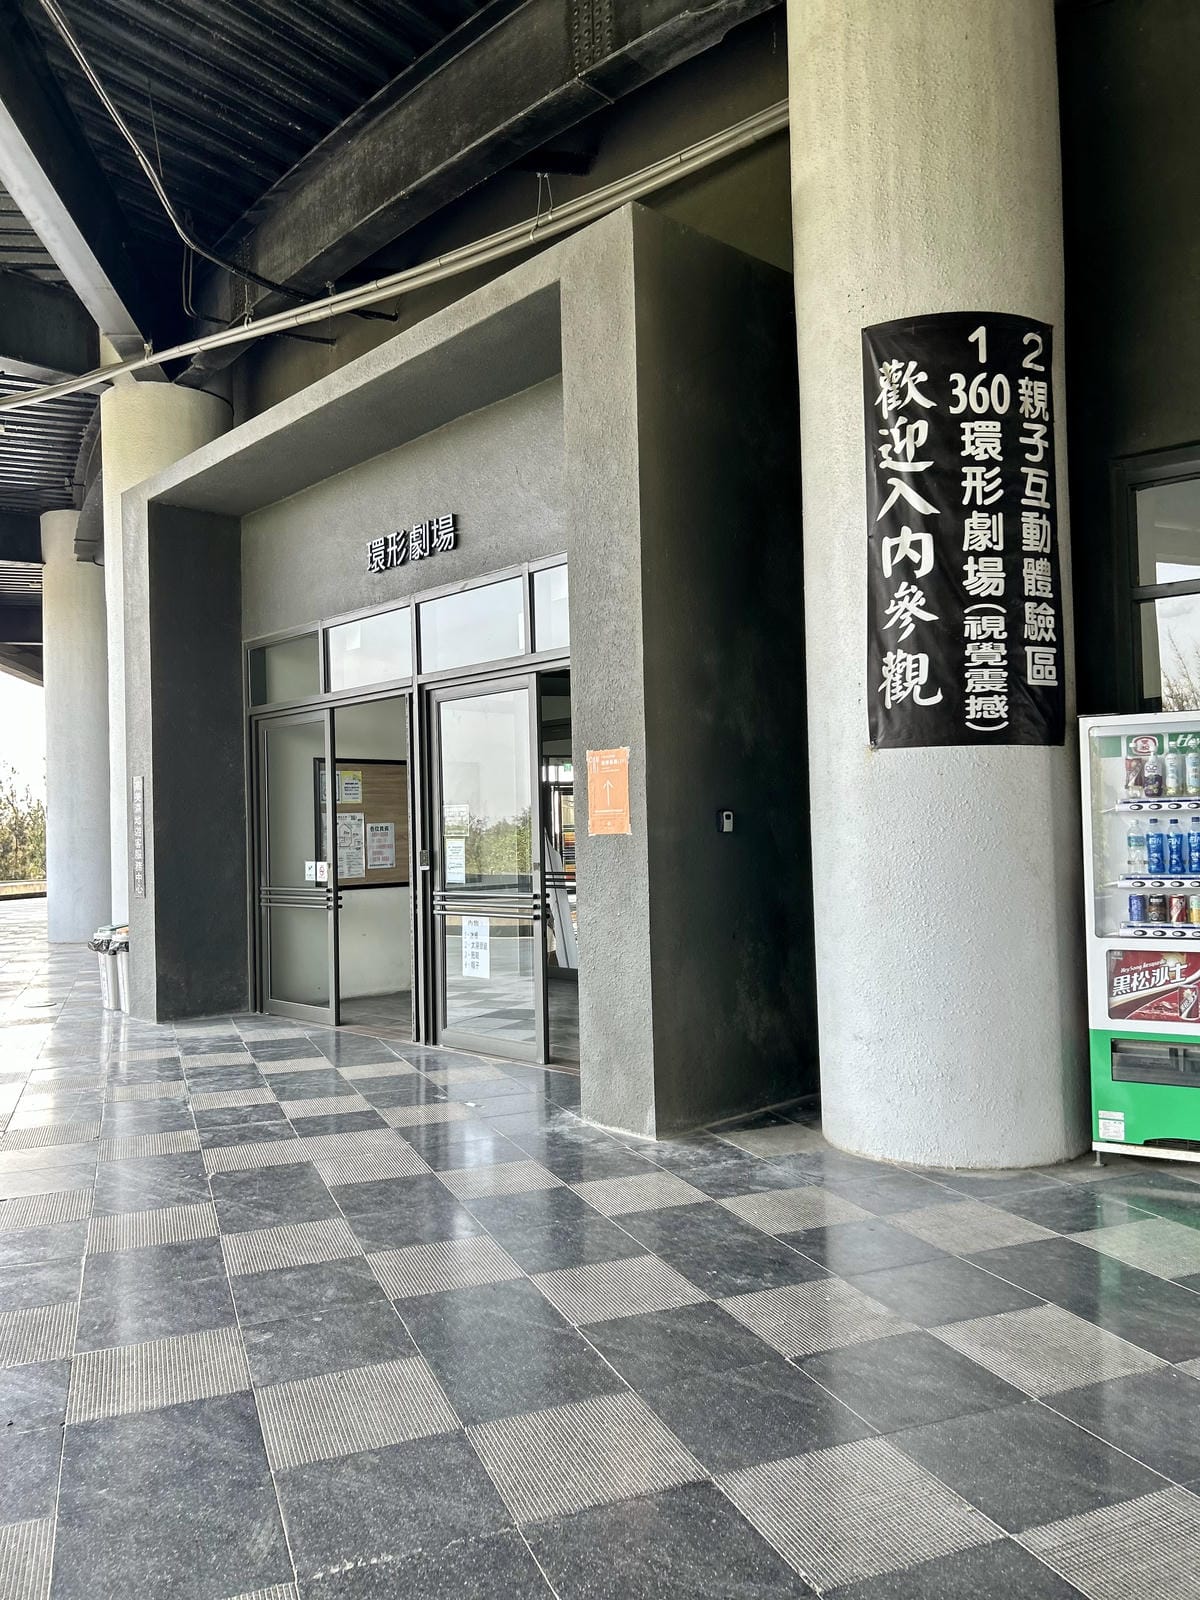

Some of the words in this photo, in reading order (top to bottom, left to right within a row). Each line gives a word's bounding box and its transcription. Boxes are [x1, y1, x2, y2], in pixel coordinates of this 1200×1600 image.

[366, 513, 455, 573] 環形劇場
[1112, 963, 1188, 997] 黑松沙士
